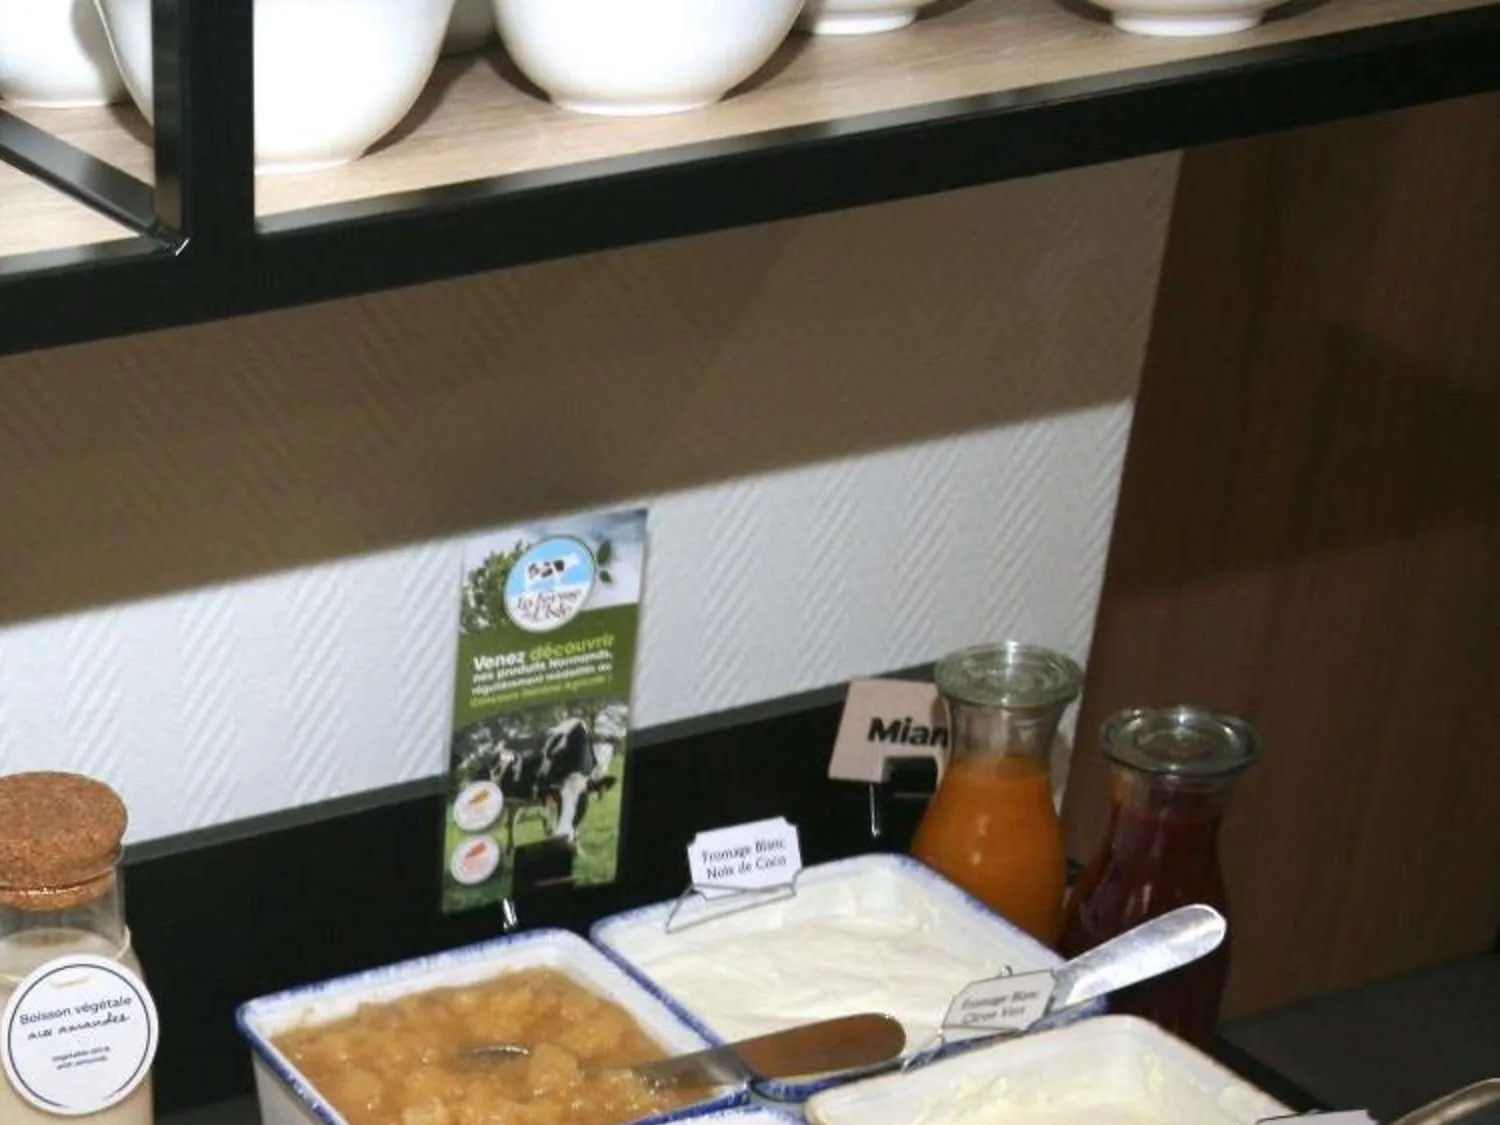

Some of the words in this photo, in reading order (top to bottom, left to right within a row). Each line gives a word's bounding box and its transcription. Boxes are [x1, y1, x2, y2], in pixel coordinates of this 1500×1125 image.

[473, 650, 526, 671] Venez
[529, 633, 615, 661] découvrir
[497, 662, 546, 681] produits
[702, 846, 751, 864] Fromage
[755, 839, 787, 853] Blanc
[738, 860, 752, 874] de
[19, 1007, 71, 1025] Boisson
[74, 996, 132, 1014] végétale
